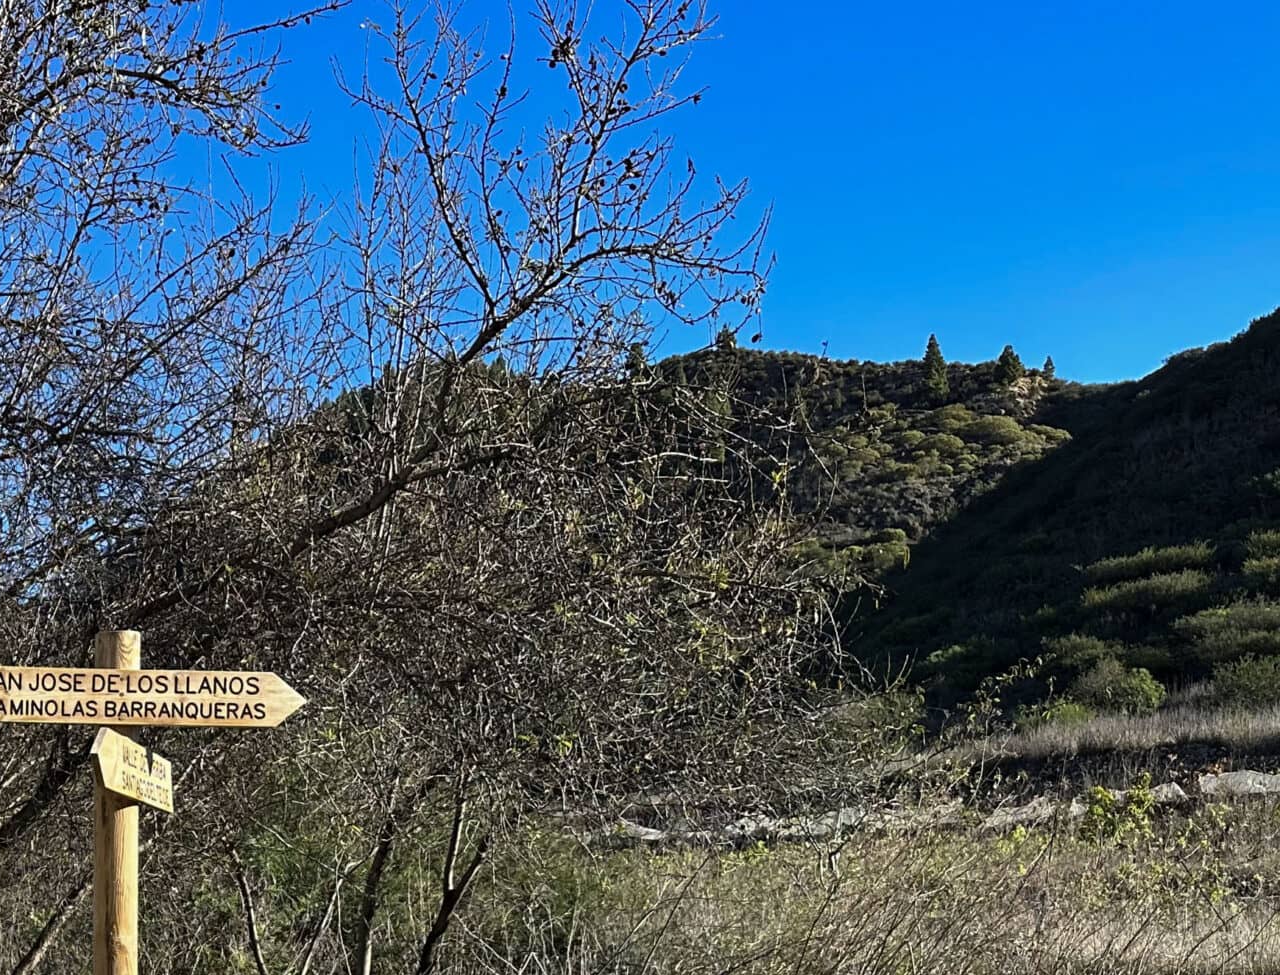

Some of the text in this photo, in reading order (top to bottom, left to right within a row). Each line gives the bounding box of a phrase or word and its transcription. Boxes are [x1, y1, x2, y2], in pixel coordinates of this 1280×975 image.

[28, 672, 87, 692] JOSE
[91, 673, 121, 693] DE
[125, 674, 169, 694] LOS
[173, 675, 260, 696] LLANOS
[104, 700, 266, 721] BARRANQUERAS
